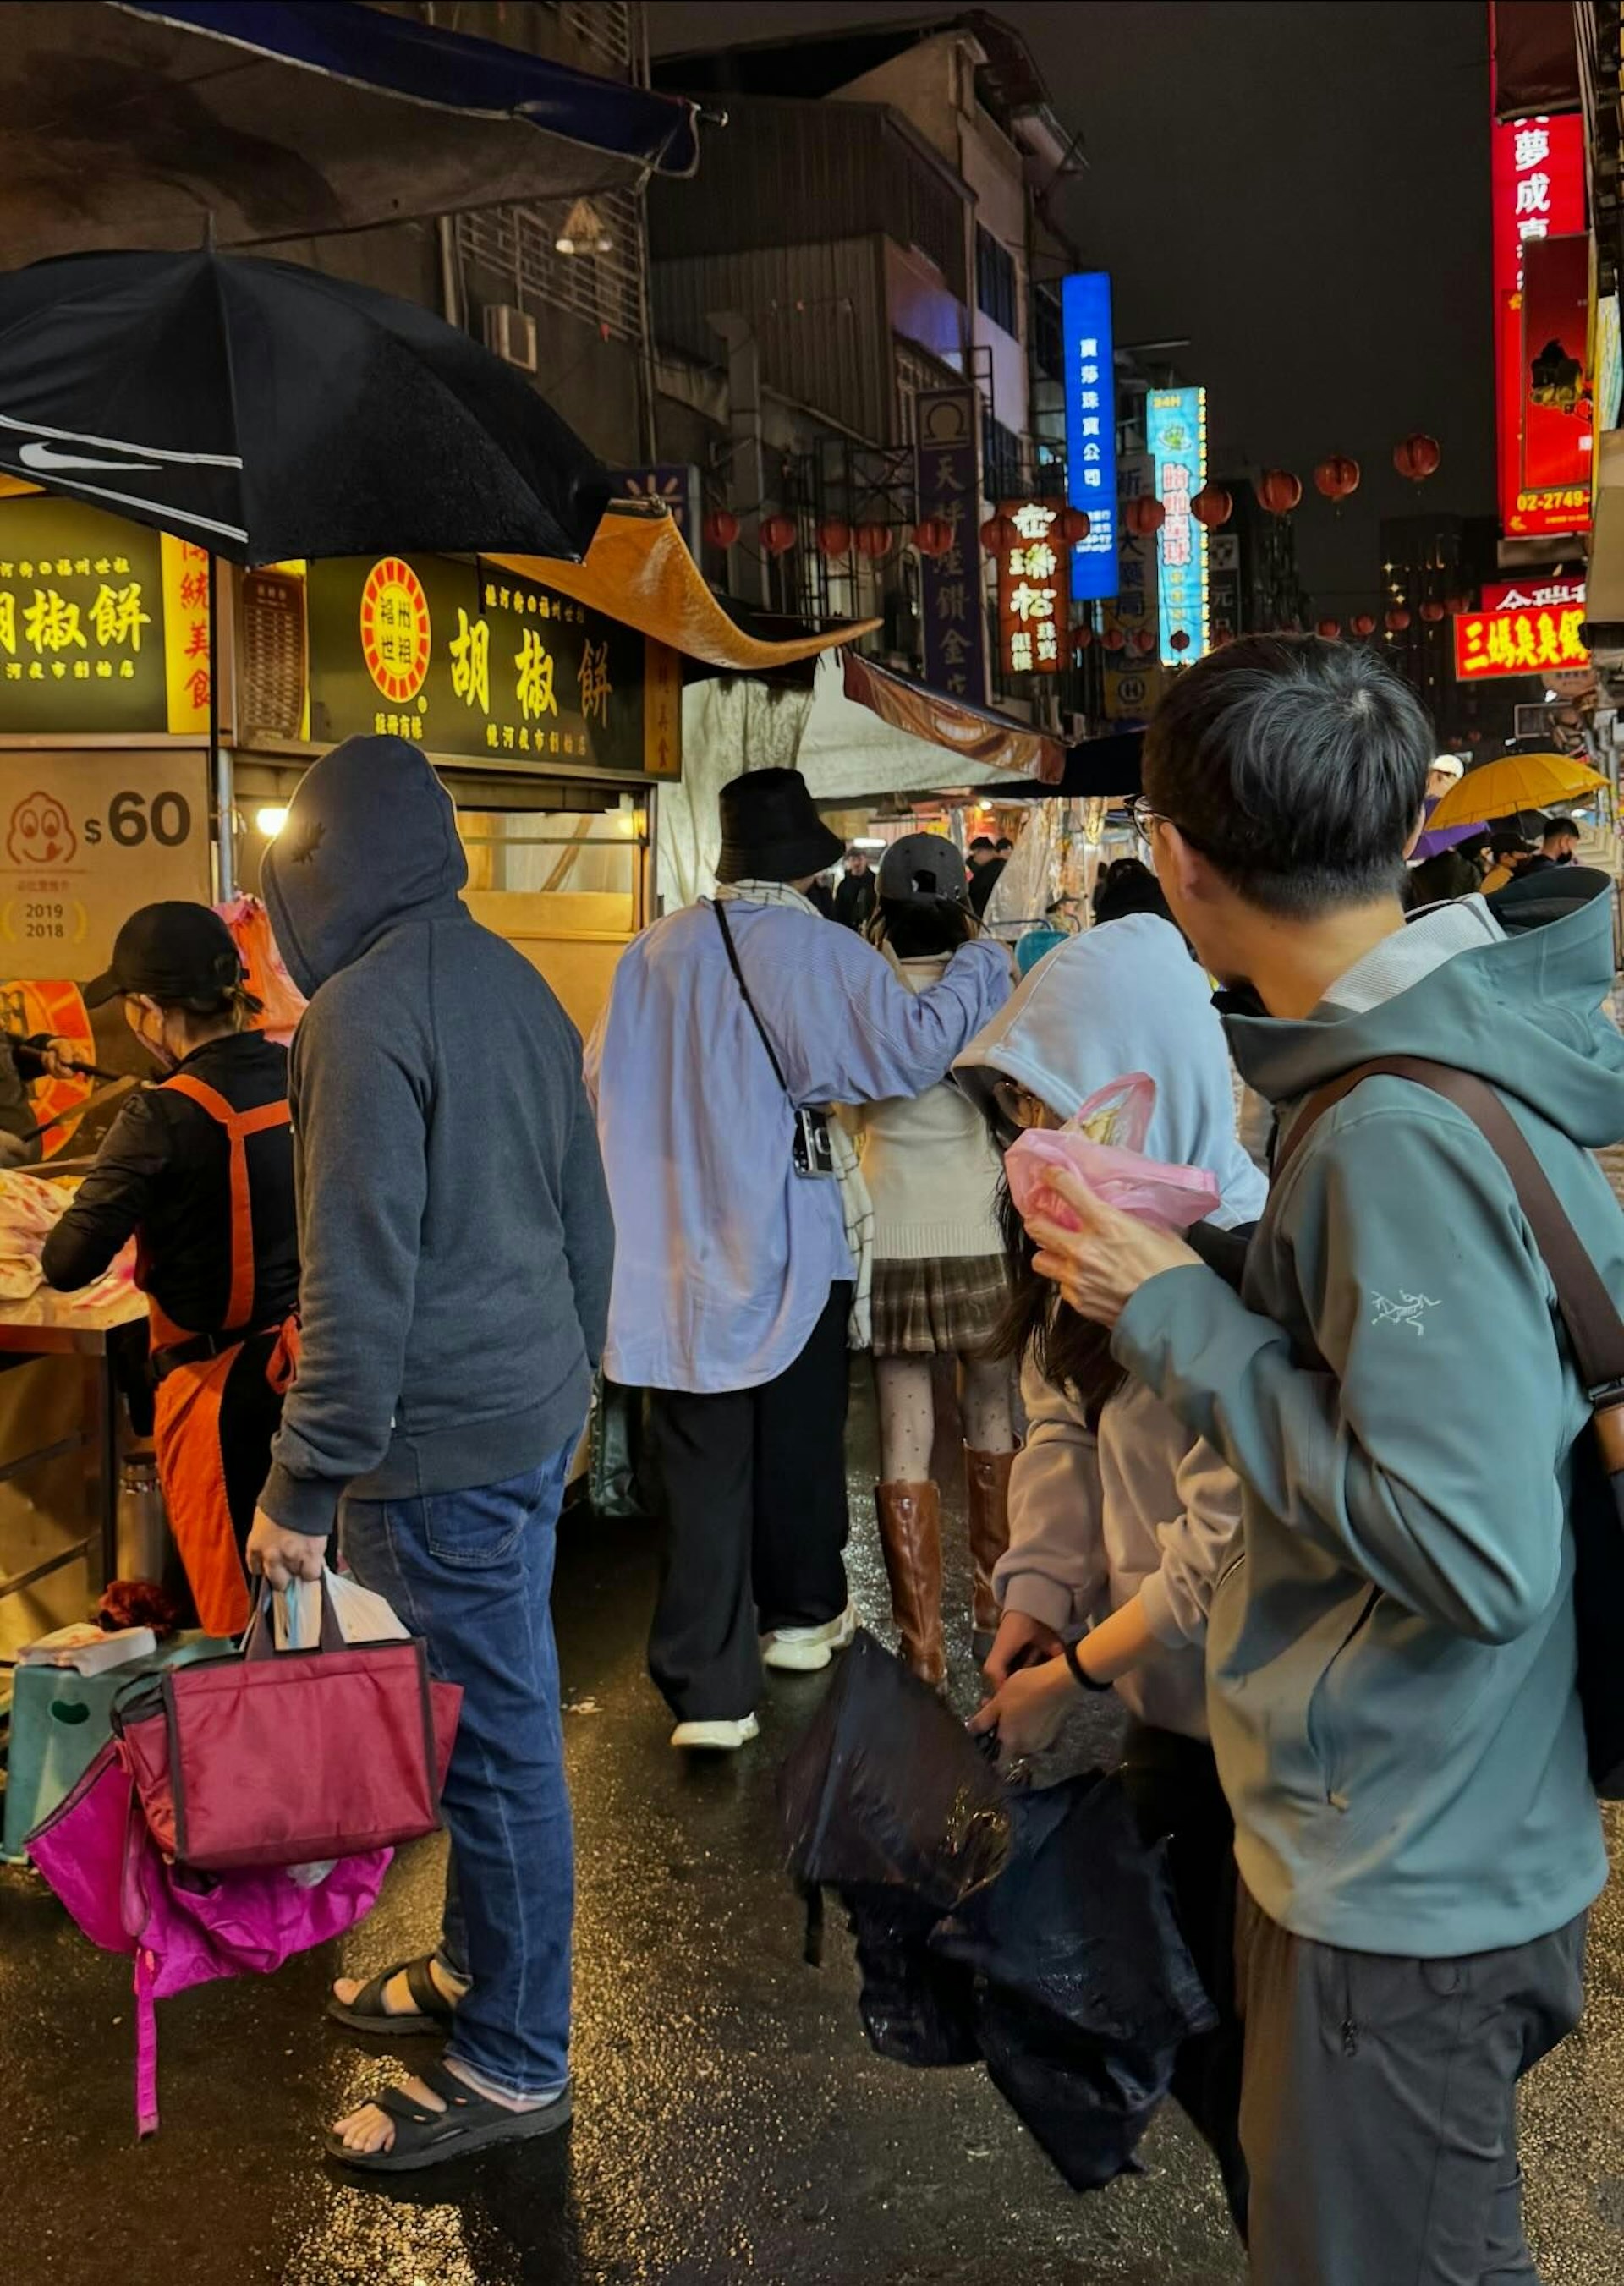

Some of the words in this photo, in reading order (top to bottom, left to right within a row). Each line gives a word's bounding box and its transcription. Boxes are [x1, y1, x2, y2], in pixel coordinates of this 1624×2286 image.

[1512, 116, 1552, 290] 夢成真
[1116, 468, 1146, 619] 新大藥局
[449, 606, 613, 730] 胡椒餅
[1463, 608, 1590, 672] 三媽臭臭鍋
[85, 791, 191, 847] $60
[26, 903, 63, 918] 2019
[26, 924, 64, 938] 2018
